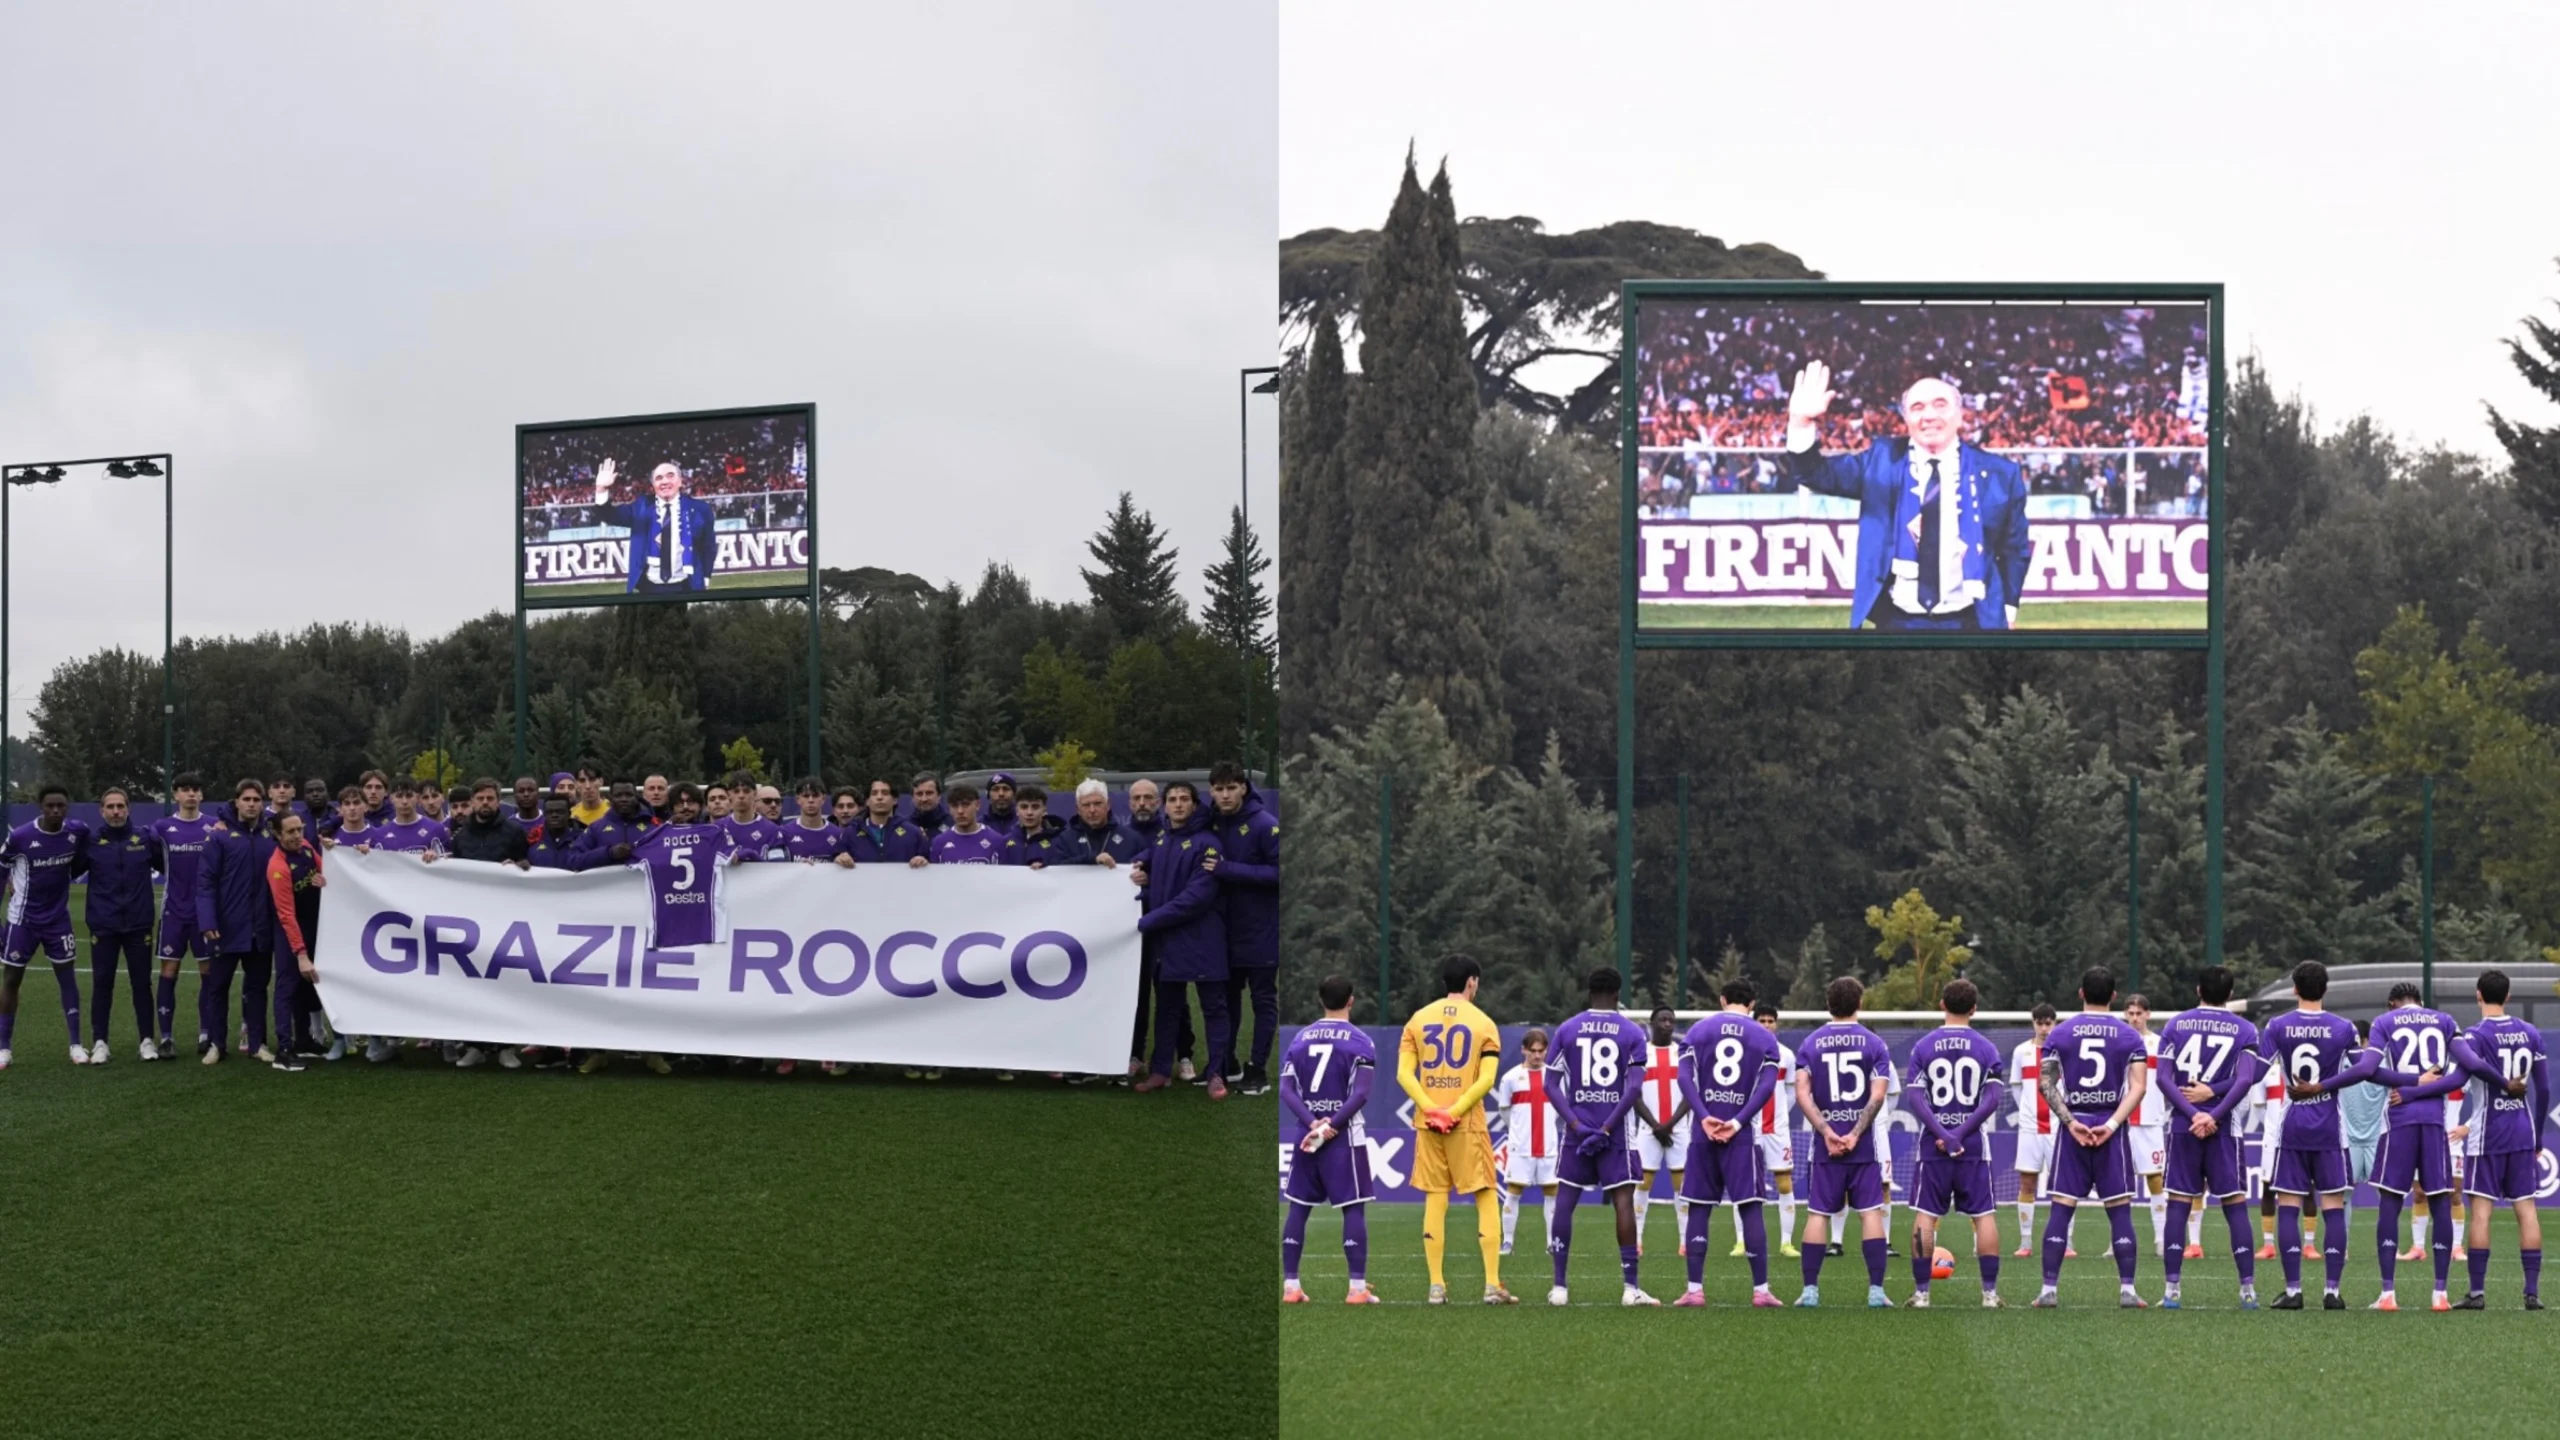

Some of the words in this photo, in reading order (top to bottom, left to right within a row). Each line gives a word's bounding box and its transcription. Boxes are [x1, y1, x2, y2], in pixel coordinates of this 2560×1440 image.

[663, 834, 700, 848] ROCCO
[670, 847, 695, 890] 5
[61, 934, 75, 951] 18
[360, 910, 700, 992] GRAZIE
[729, 929, 1088, 1001] ROCCO
[1301, 1028, 1352, 1041] BERTOLINI
[1422, 1023, 1472, 1070] 30
[1578, 1021, 1620, 1035] JALLOW
[1721, 1023, 1744, 1037] DELI
[1815, 1034, 1866, 1049] PERROTTI
[1934, 1036, 1971, 1052] ATZENI
[2072, 1024, 2118, 1038] SADOTTI
[2176, 1018, 2239, 1035] MONTENEGRO
[2285, 1026, 2332, 1039] TURNONE
[1308, 1043, 1334, 1093] 7
[1576, 1037, 1619, 1087] 18
[1713, 1037, 1744, 1086] 8
[2079, 1038, 2106, 1088] 5
[2175, 1033, 2234, 1083] 47
[2291, 1043, 2320, 1087] 6
[2391, 1027, 2446, 1074] 20
[2498, 1047, 2533, 1094] 10
[1821, 1051, 1866, 1102] 15
[1928, 1056, 1981, 1107] 80
